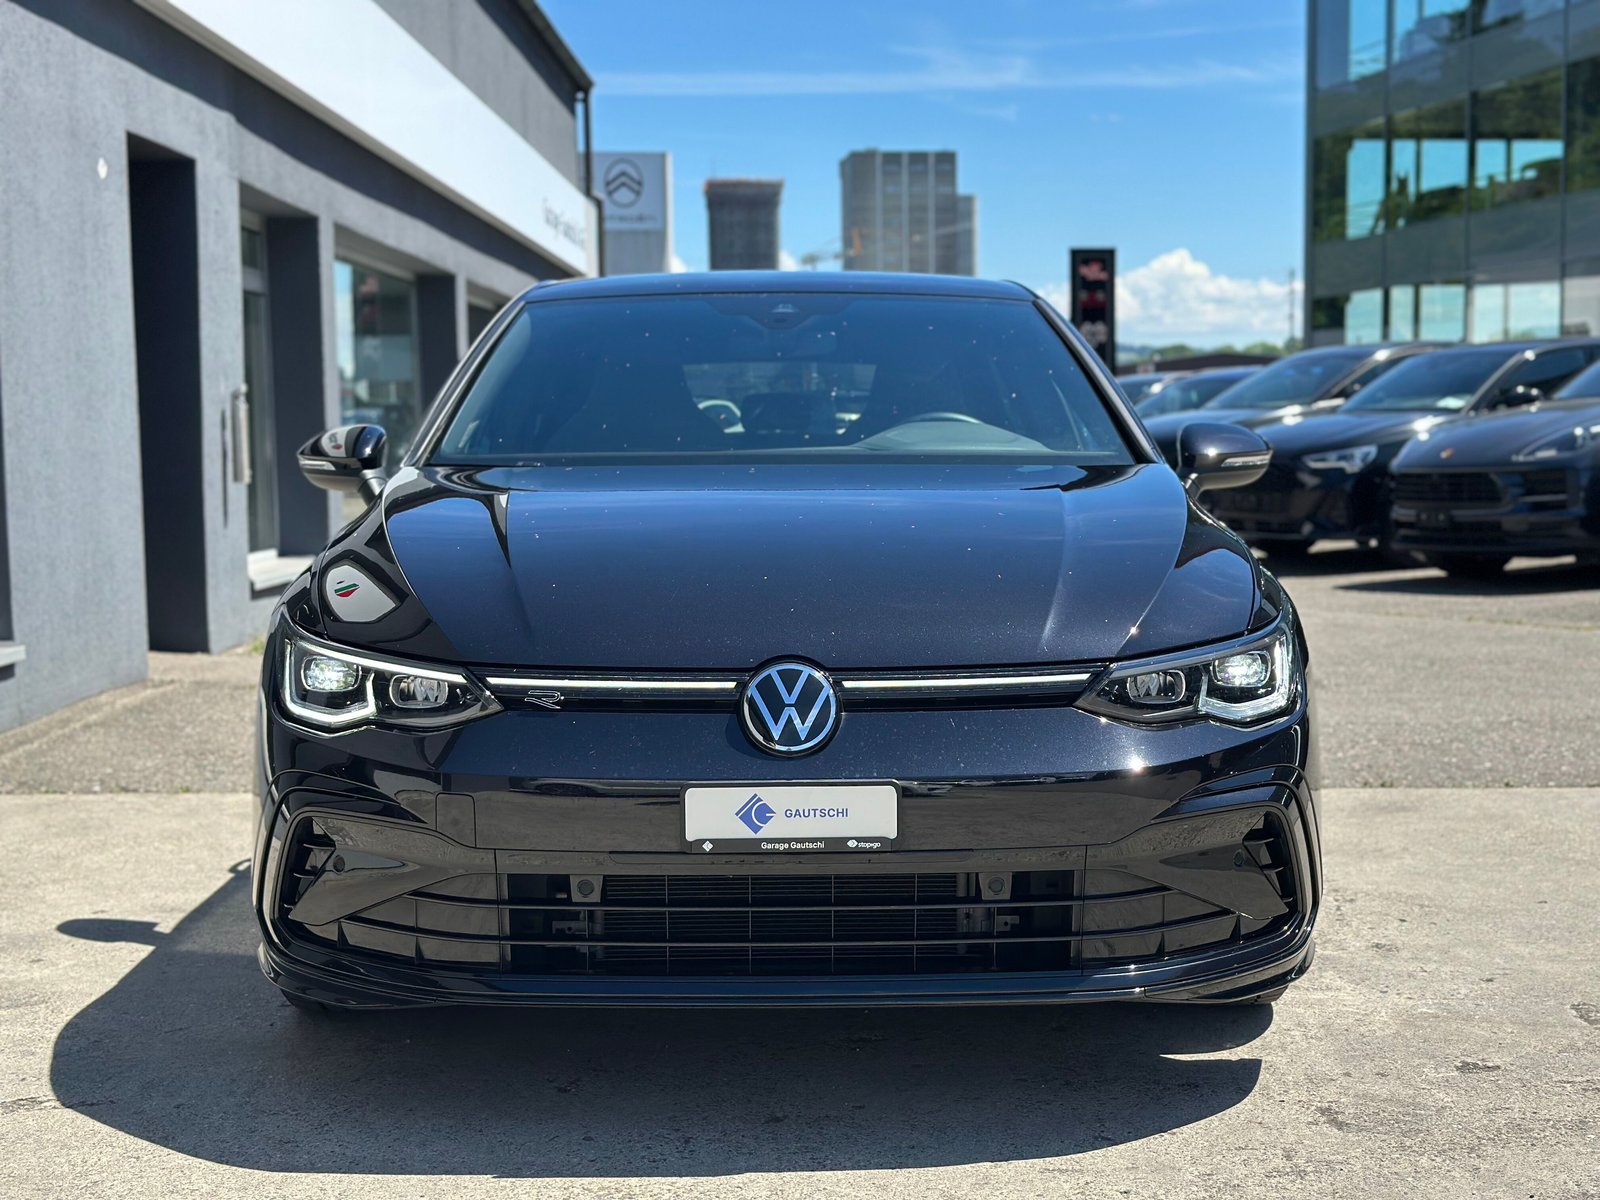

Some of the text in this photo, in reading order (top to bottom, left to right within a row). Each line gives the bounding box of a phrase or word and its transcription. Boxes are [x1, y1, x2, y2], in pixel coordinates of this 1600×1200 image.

[784, 808, 849, 818] GAUTSCHI
[761, 841, 825, 850] Garage Gautschi
